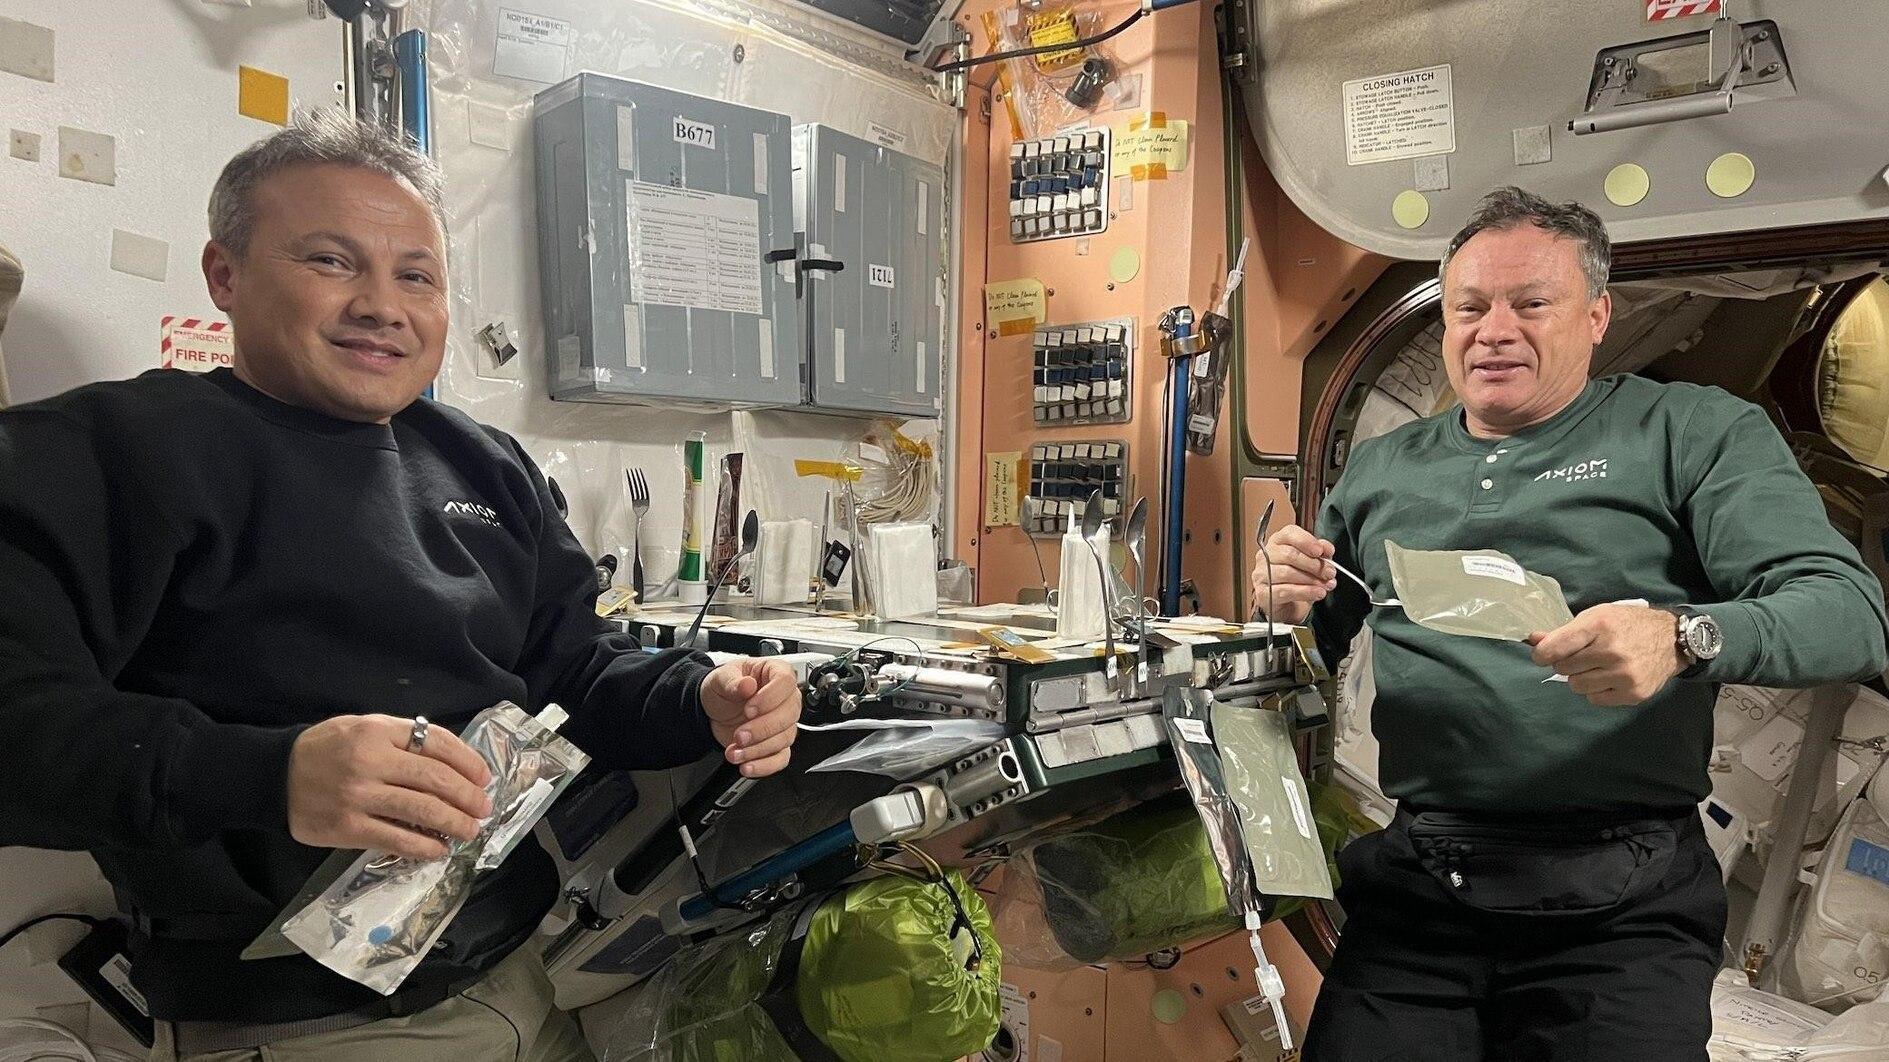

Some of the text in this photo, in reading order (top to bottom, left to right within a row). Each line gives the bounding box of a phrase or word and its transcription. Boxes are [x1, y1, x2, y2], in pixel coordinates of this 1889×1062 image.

[1363, 72, 1434, 91] CLOSING HATCH
[675, 122, 713, 145] B677
[175, 348, 207, 362] FIRE
[1533, 458, 1608, 482] AXIOM
[1565, 471, 1607, 483] SPACE
